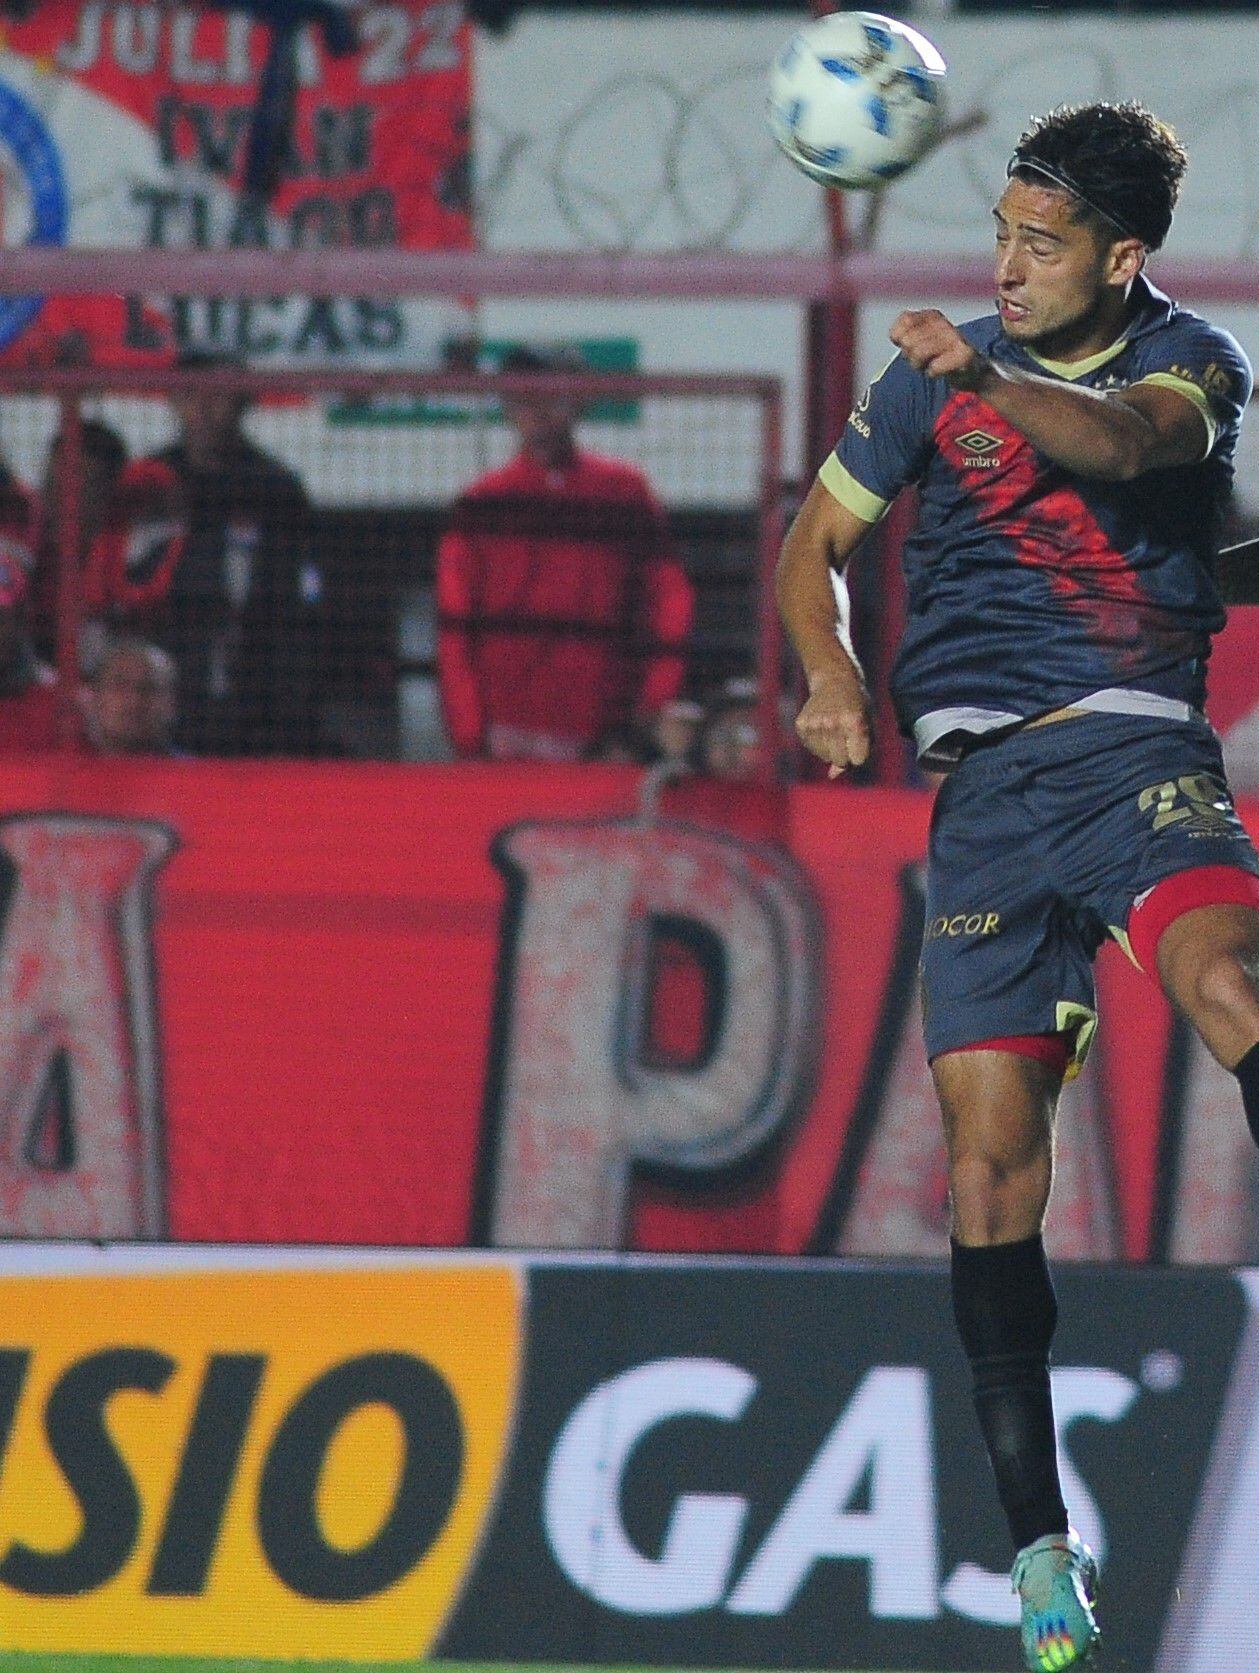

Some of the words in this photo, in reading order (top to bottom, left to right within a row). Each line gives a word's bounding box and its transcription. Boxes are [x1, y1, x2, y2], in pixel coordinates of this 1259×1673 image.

[356, 4, 465, 85] 22
[157, 95, 374, 178] IVN
[961, 455, 1001, 468] umbro
[0, 1345, 469, 1604] SIO
